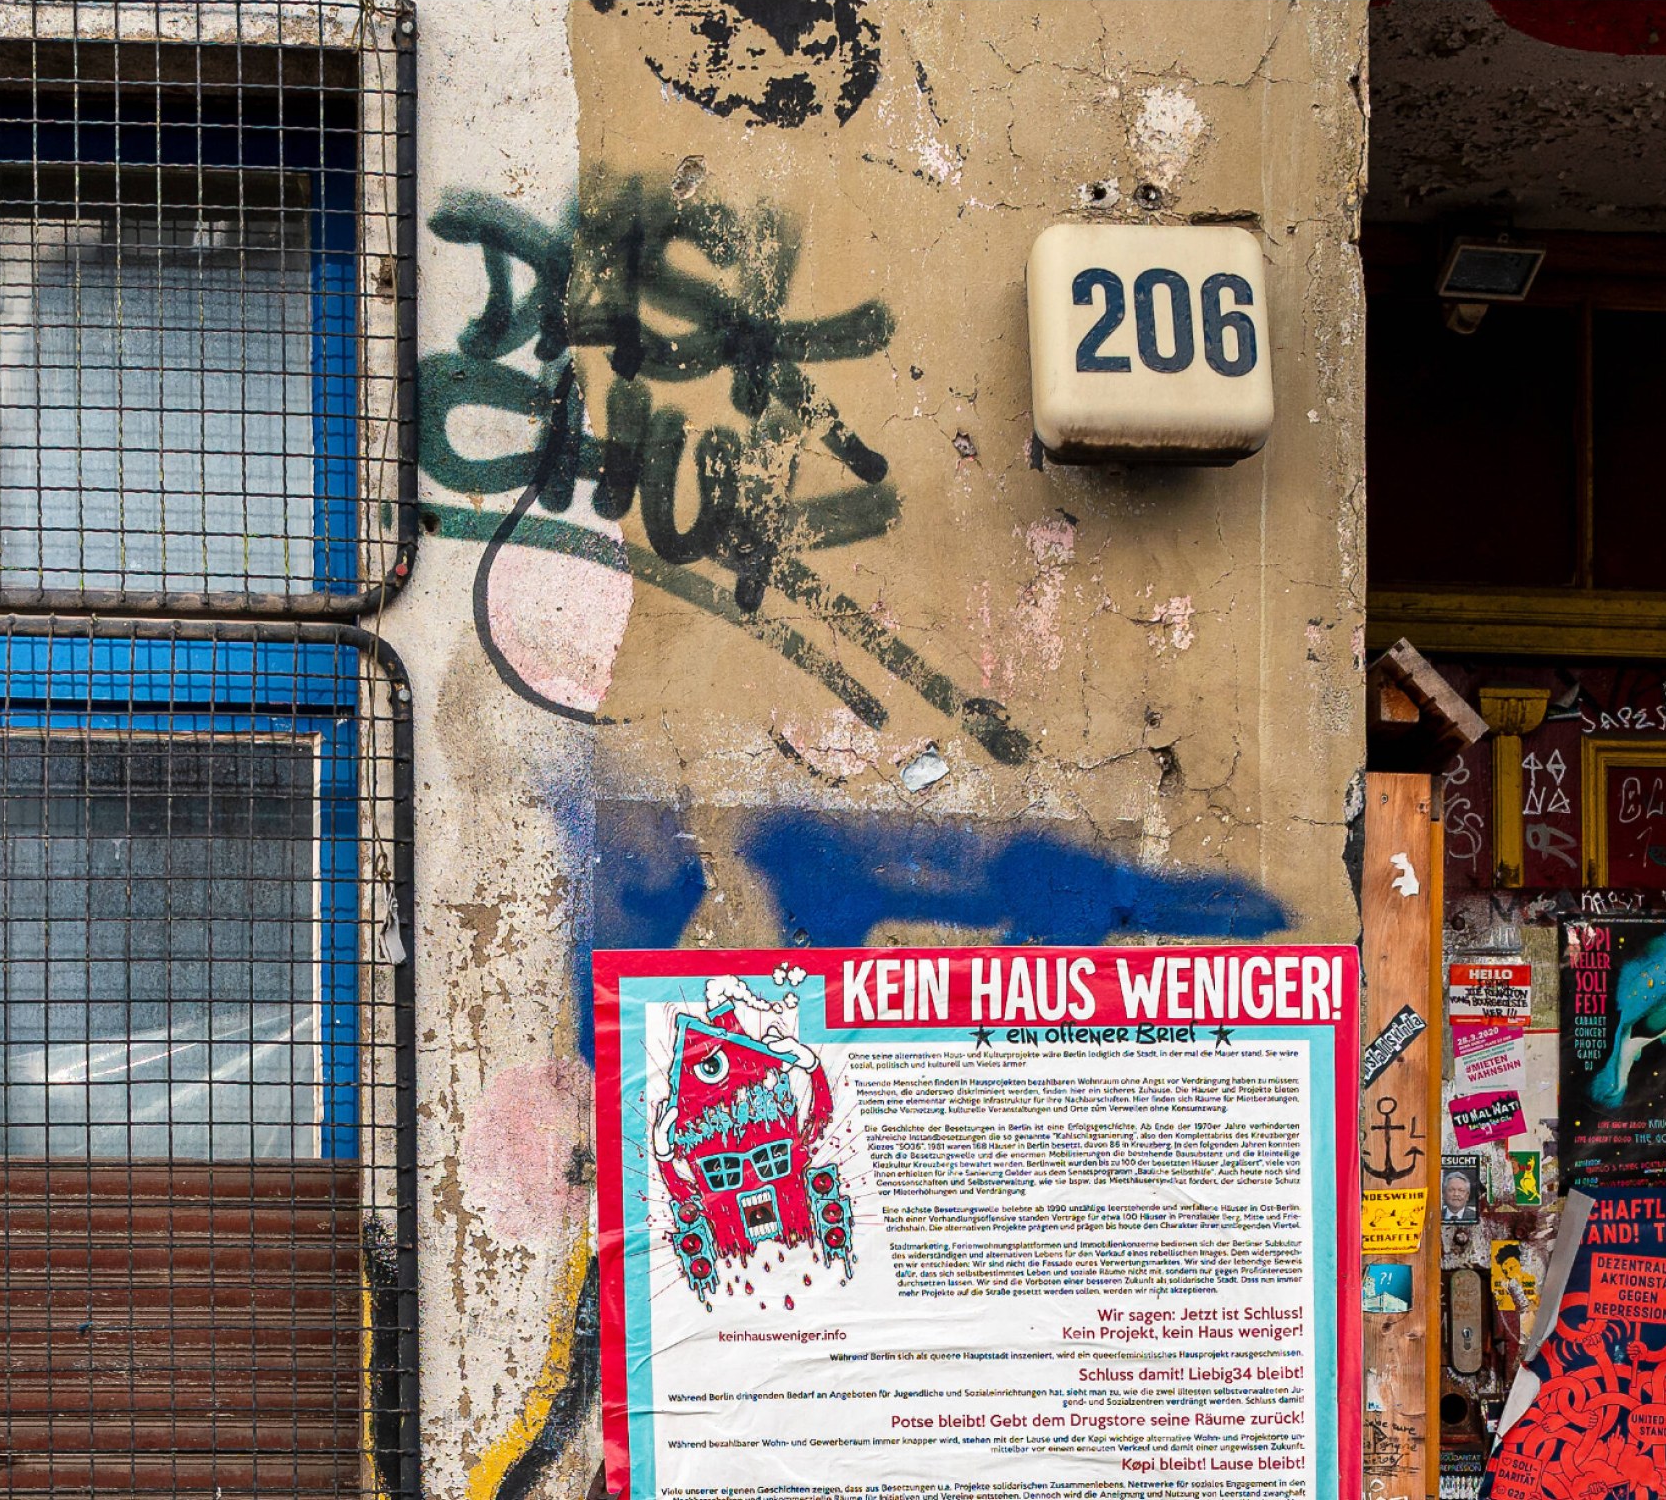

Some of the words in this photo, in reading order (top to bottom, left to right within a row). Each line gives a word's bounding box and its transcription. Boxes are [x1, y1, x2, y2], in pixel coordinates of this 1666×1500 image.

[1071, 266, 1258, 377] 206
[1469, 968, 1513, 980] HELLO
[1575, 971, 1607, 993] SOLI
[842, 957, 950, 1023] KEIN
[971, 956, 1097, 1023] HAUS
[1116, 954, 1343, 1021] WENIGER!
[1575, 994, 1608, 1015] FEST
[1574, 1040, 1608, 1050] PHOTOS
[1467, 1060, 1522, 1082] WAHNSINN
[1634, 1133, 1652, 1144] THE
[1441, 1156, 1477, 1166] ESUCHT
[1618, 1289, 1658, 1304] GEGEN
[1097, 1308, 1125, 1322] Wir
[1128, 1311, 1176, 1326] sagen:
[1180, 1308, 1218, 1321] Jetzt
[1222, 1307, 1240, 1321] ist
[1244, 1306, 1303, 1321] Schluss!
[718, 1328, 848, 1344] keinhausweniger.info
[1062, 1326, 1095, 1340] Kein
[1100, 1324, 1159, 1343] Projekt,
[1162, 1325, 1194, 1339] kein
[1198, 1325, 1234, 1338] Haus
[1238, 1323, 1303, 1341] weniger!
[1079, 1368, 1134, 1381] Schluss
[1139, 1367, 1184, 1381] damit!
[1189, 1367, 1252, 1384] Liebig34
[1257, 1366, 1303, 1380] bleibt!
[891, 1415, 934, 1428] Potse
[938, 1414, 986, 1428] bleibt!
[990, 1414, 1028, 1427] Gebt
[1032, 1413, 1065, 1427] dem
[1070, 1413, 1146, 1430] Drugstore
[1150, 1413, 1191, 1426] seine
[1195, 1413, 1246, 1426] Räume
[1250, 1411, 1305, 1425] zurück!
[1632, 1414, 1664, 1426] UNITED
[1122, 1457, 1154, 1474] Køpi
[1160, 1457, 1205, 1470] bleibt!
[1211, 1457, 1253, 1470] Lause
[1259, 1456, 1304, 1470] bleibt!
[1512, 1459, 1538, 1474] SOLI-
[1498, 1468, 1536, 1485] DARITÄT
